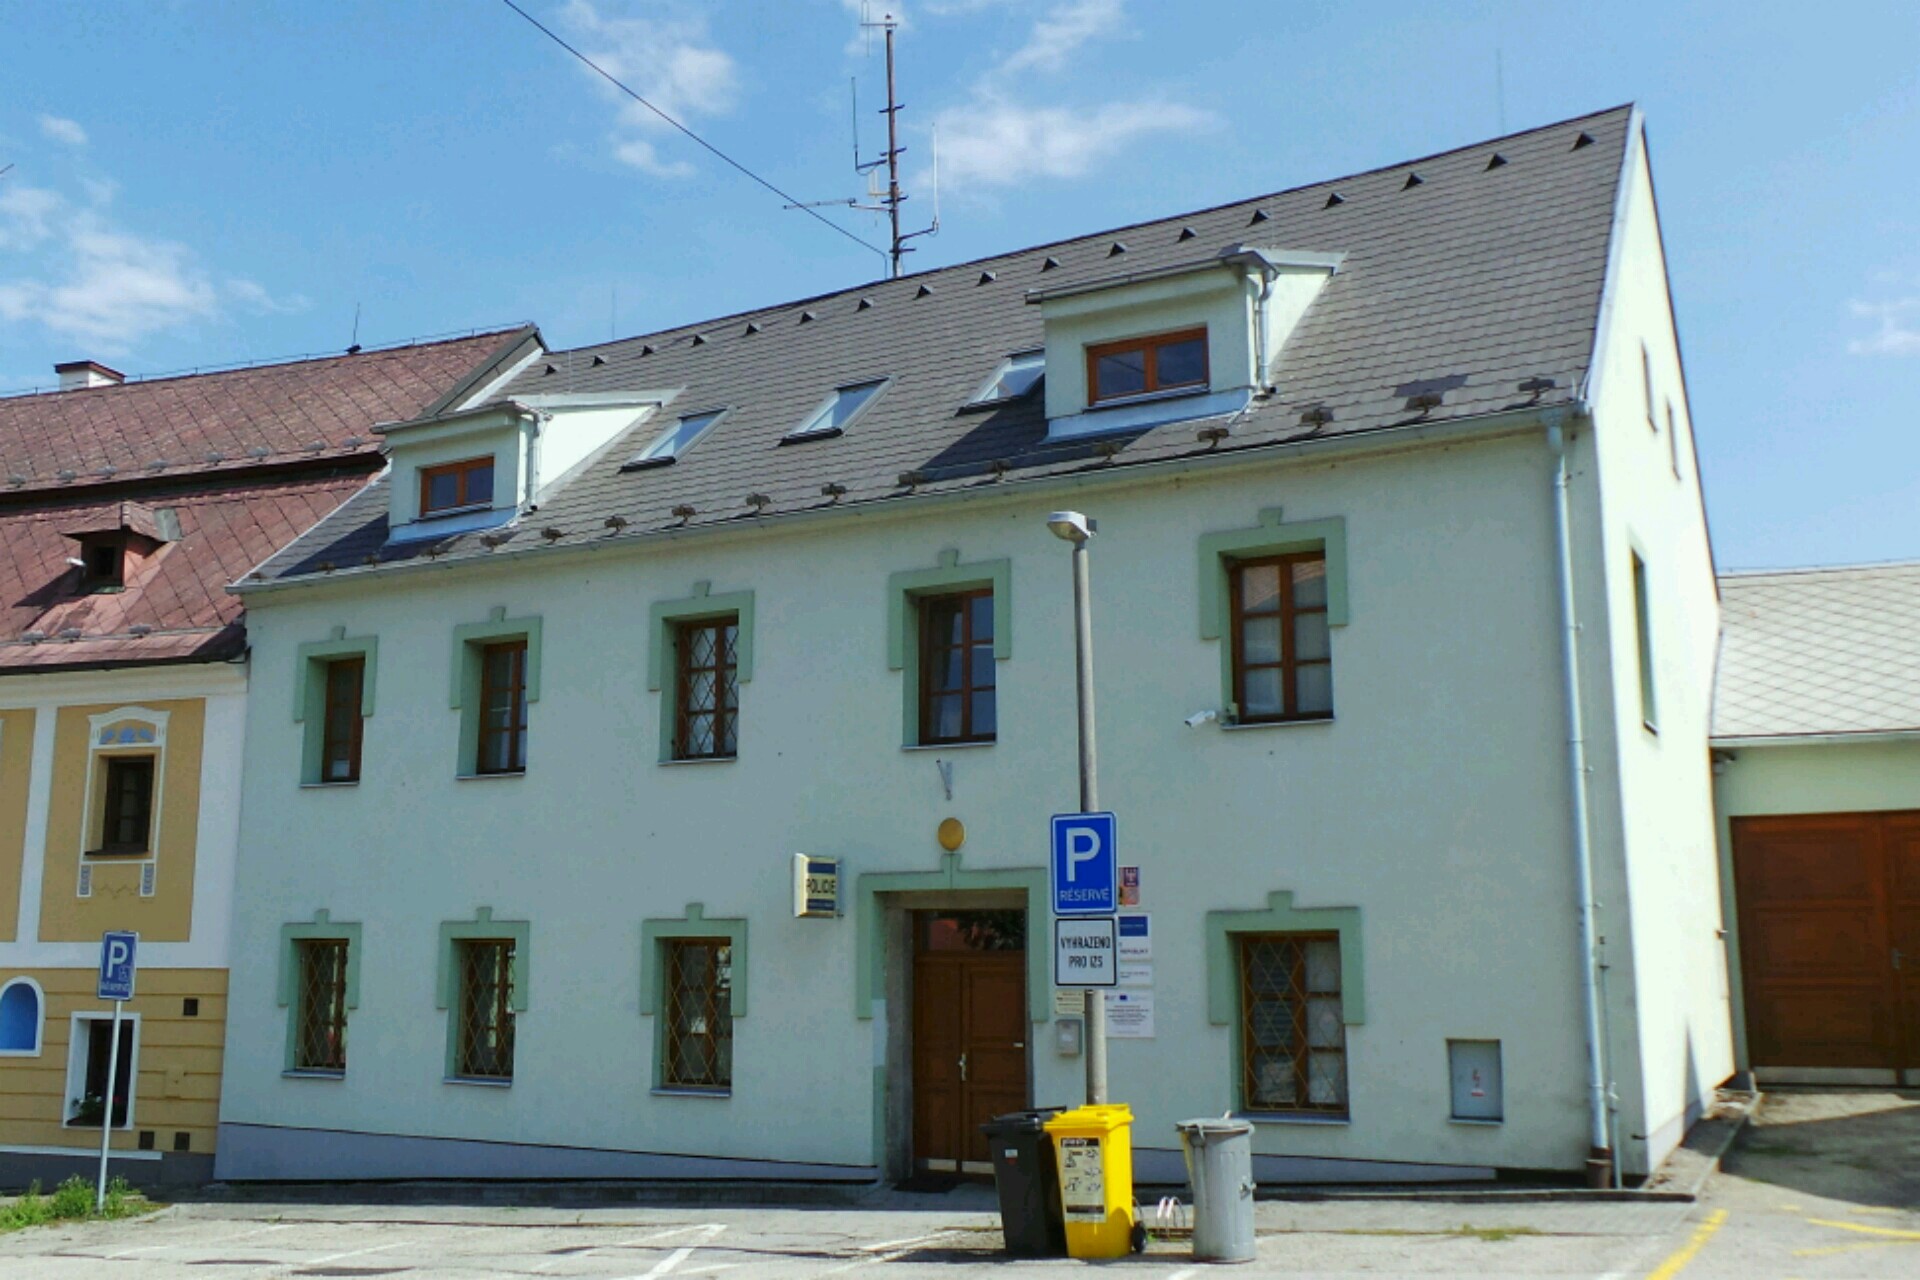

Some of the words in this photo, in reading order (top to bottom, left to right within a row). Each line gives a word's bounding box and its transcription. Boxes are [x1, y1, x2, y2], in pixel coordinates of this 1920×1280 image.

[1066, 827, 1101, 882] P
[1060, 935, 1110, 949] VYHRAZENO
[107, 941, 128, 978] P
[1068, 955, 1087, 968] PRO
[1090, 955, 1103, 968] IZS
